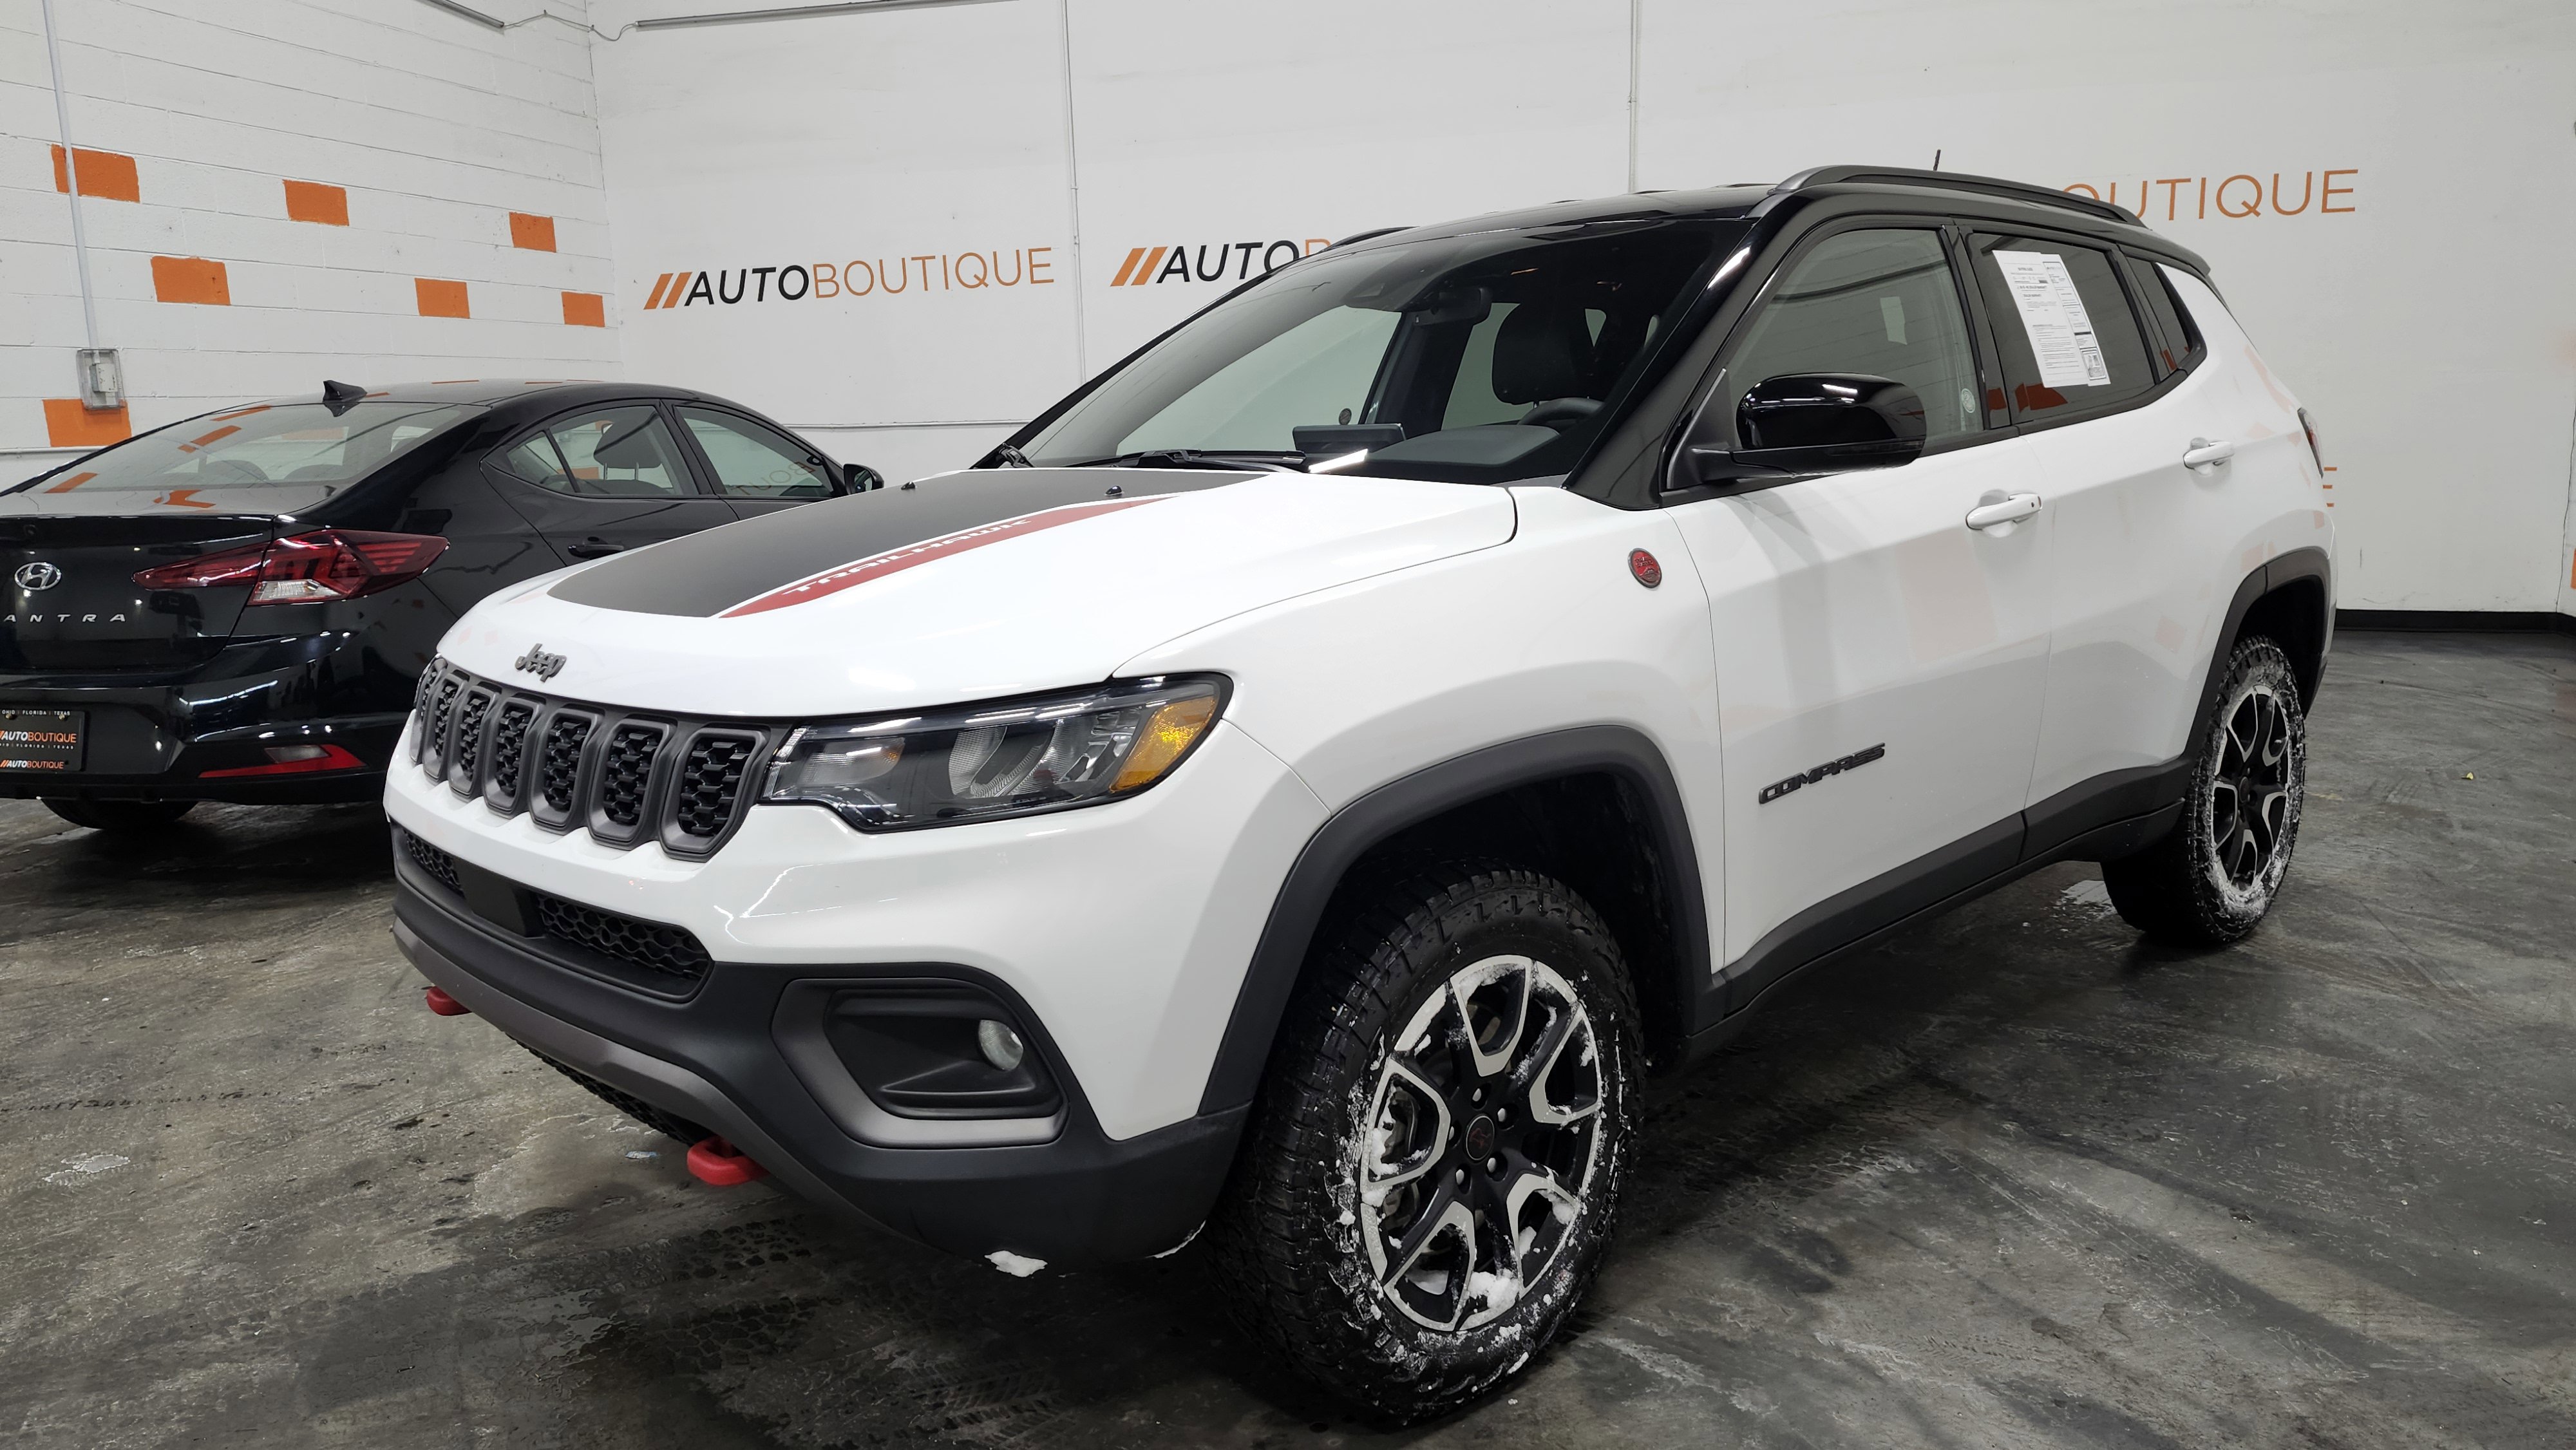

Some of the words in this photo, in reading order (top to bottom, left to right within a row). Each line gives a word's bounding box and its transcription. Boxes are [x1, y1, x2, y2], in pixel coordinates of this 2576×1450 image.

[2063, 169, 2358, 221] UTIQUE
[684, 247, 1054, 307] AUTOBOUTIQUE
[782, 518, 1032, 595] TRAILHAWK
[515, 643, 567, 683] Jeep
[1, 731, 77, 743] AUTOBOUTIQUE
[6, 760, 64, 769] AUTOBOUTIQUE
[1759, 742, 1885, 804] COMPASS
